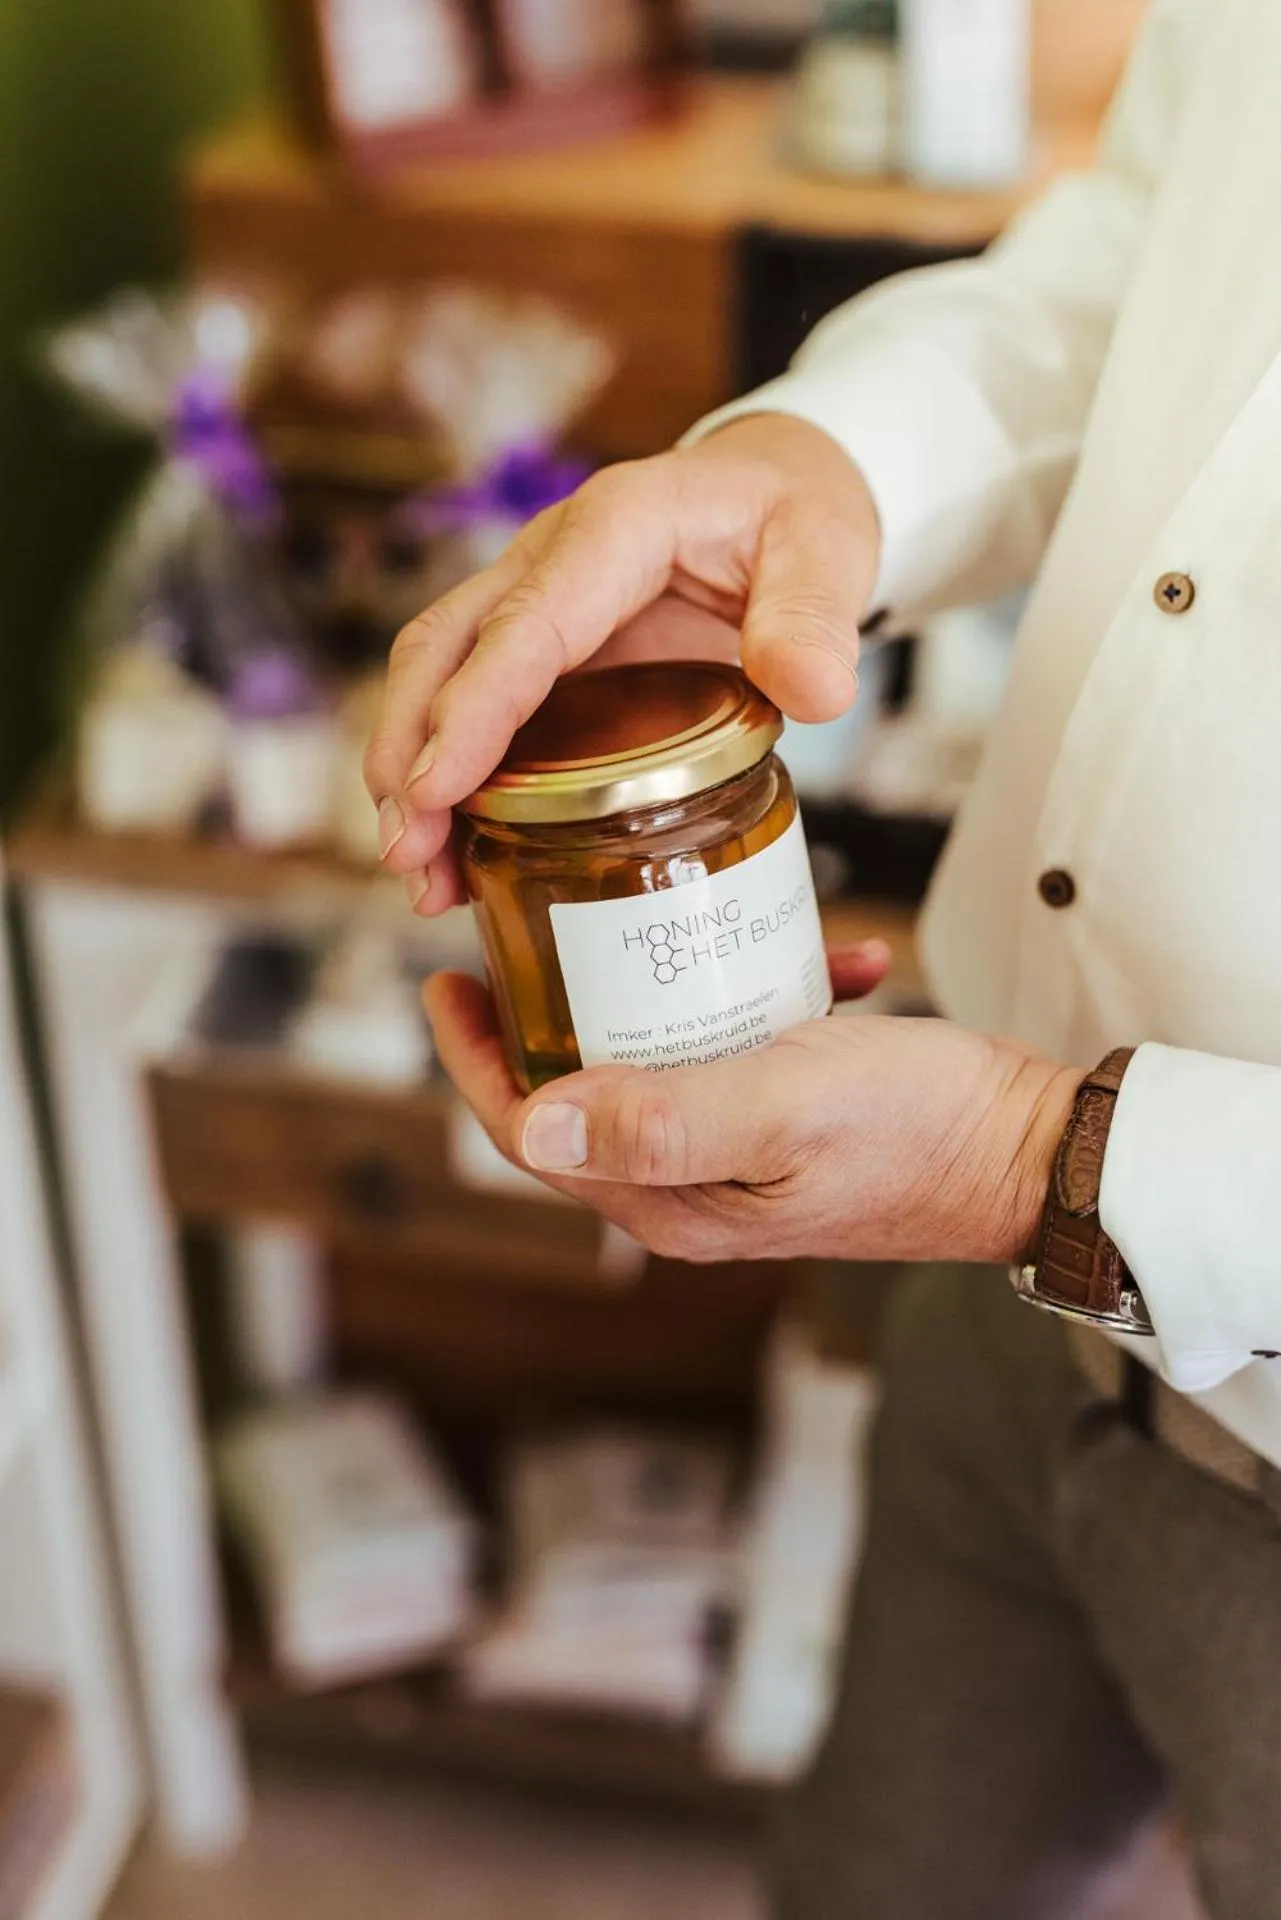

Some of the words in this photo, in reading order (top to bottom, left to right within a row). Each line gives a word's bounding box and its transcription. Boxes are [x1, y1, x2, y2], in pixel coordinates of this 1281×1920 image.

[622, 899, 741, 950] HONING
[691, 928, 743, 965] HET
[608, 1029, 652, 1042] Imker
[664, 1021, 696, 1036] Kris
[611, 1013, 767, 1060] www.hetbuskruid.be
